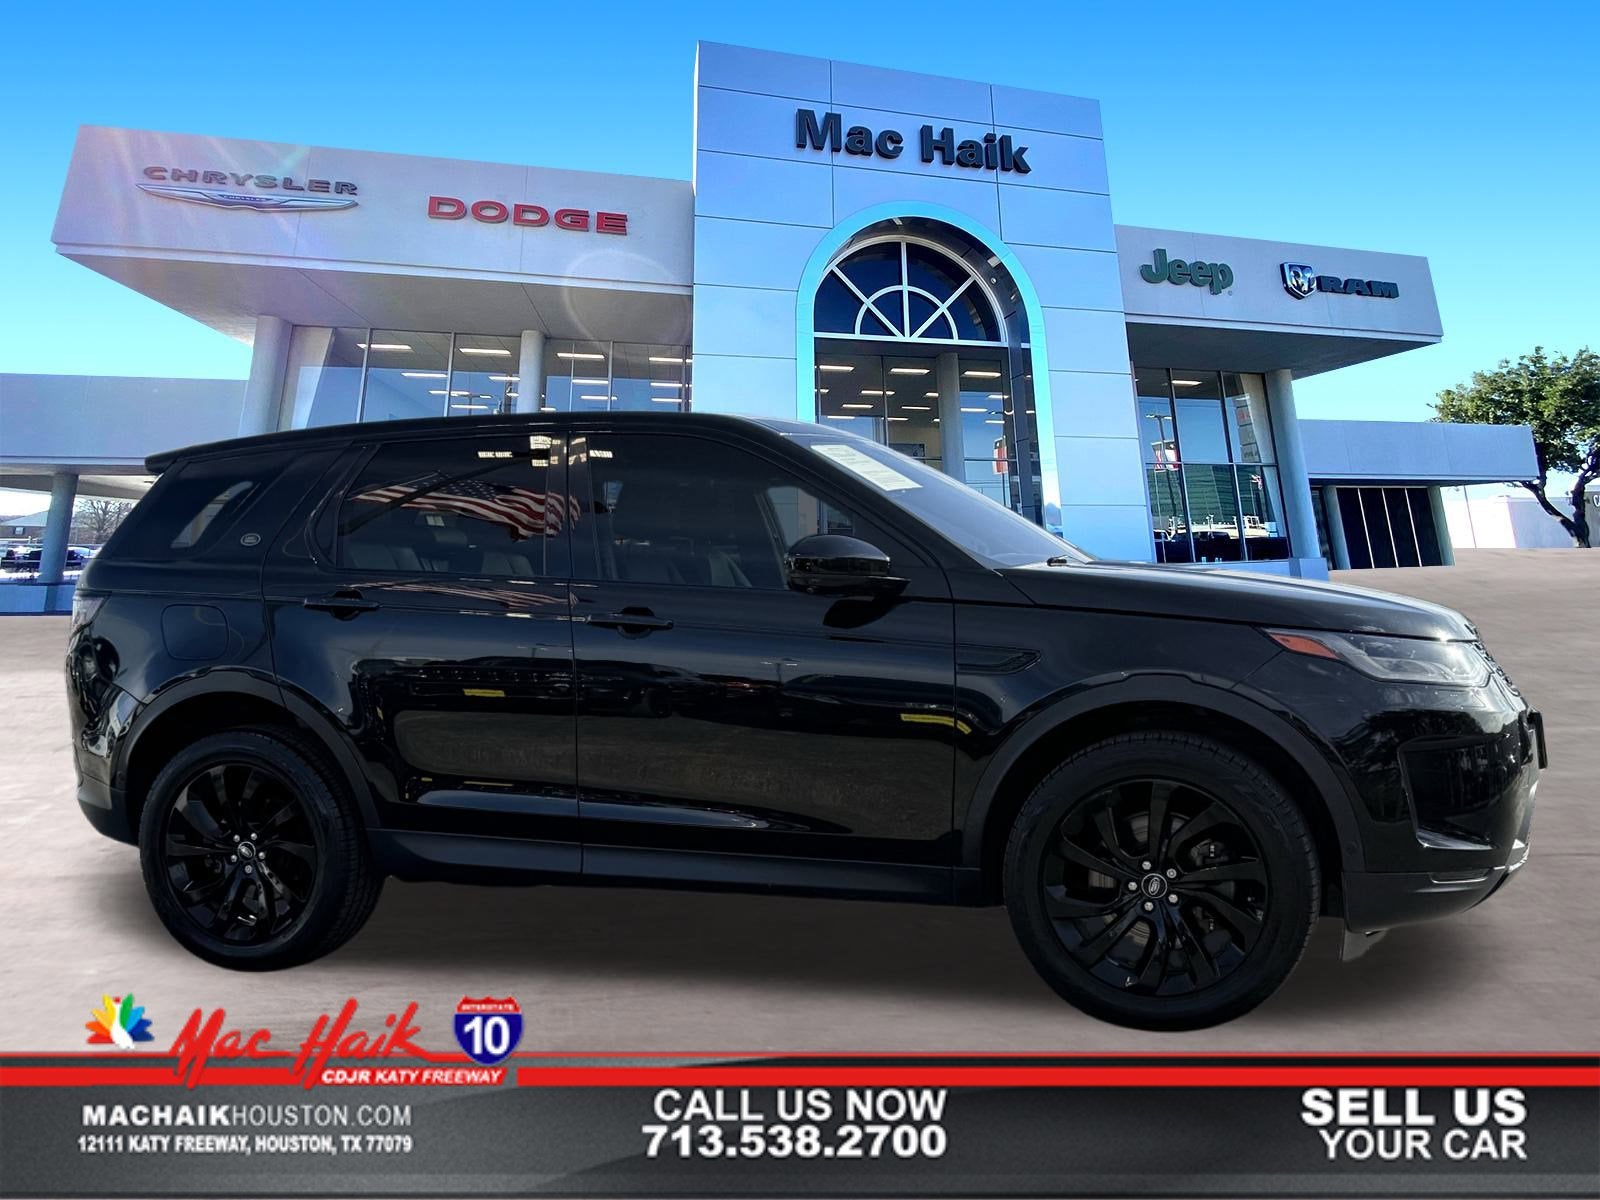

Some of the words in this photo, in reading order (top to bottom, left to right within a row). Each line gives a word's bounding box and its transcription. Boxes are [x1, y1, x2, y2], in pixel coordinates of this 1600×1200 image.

[796, 108, 904, 159] Mac
[919, 124, 1032, 174] Haik
[143, 166, 359, 196] CHRYSLER
[428, 196, 628, 236] DODGE
[1140, 248, 1234, 295] Jeep
[1316, 275, 1399, 299] RAM
